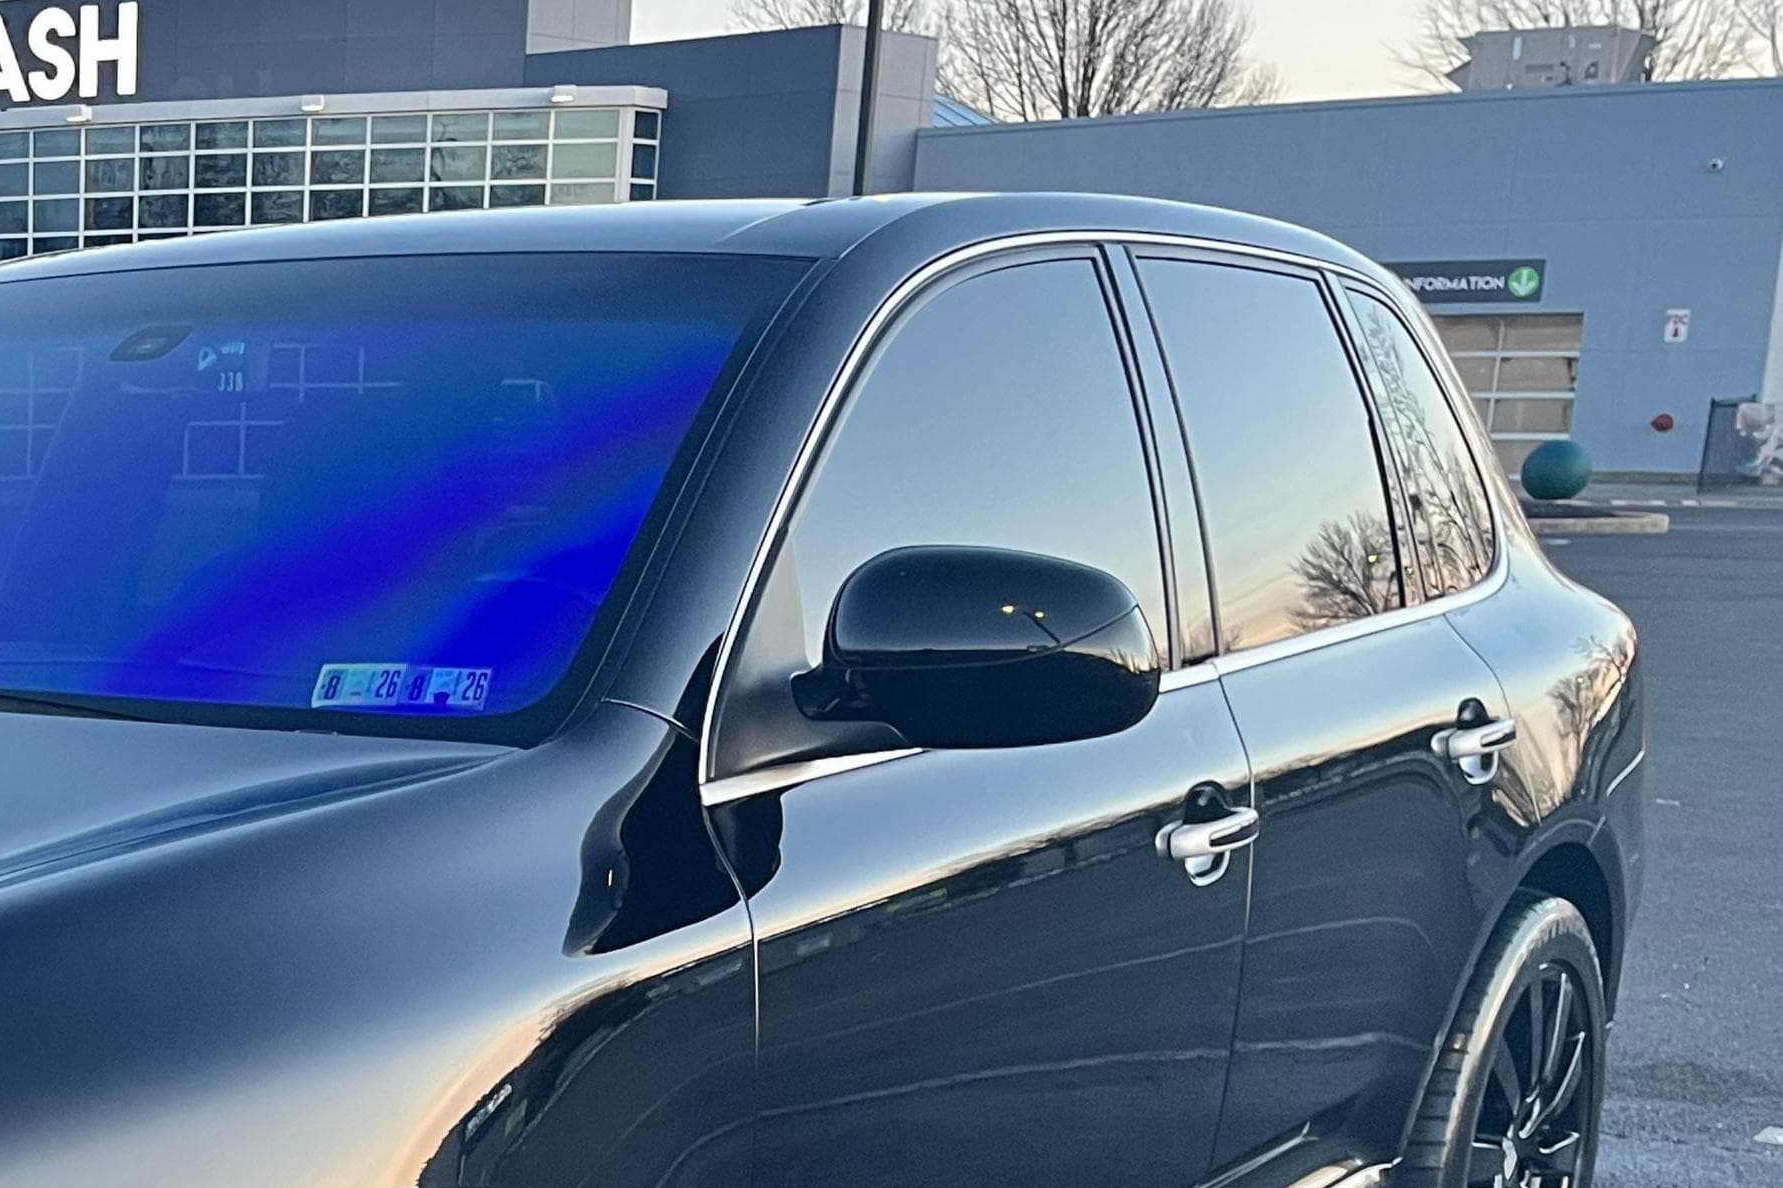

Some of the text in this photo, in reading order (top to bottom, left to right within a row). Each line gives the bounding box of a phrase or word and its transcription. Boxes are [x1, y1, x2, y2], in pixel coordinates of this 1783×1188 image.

[1404, 276, 1506, 291] NFORMATION
[375, 670, 401, 699] 26
[462, 672, 488, 701] 26
